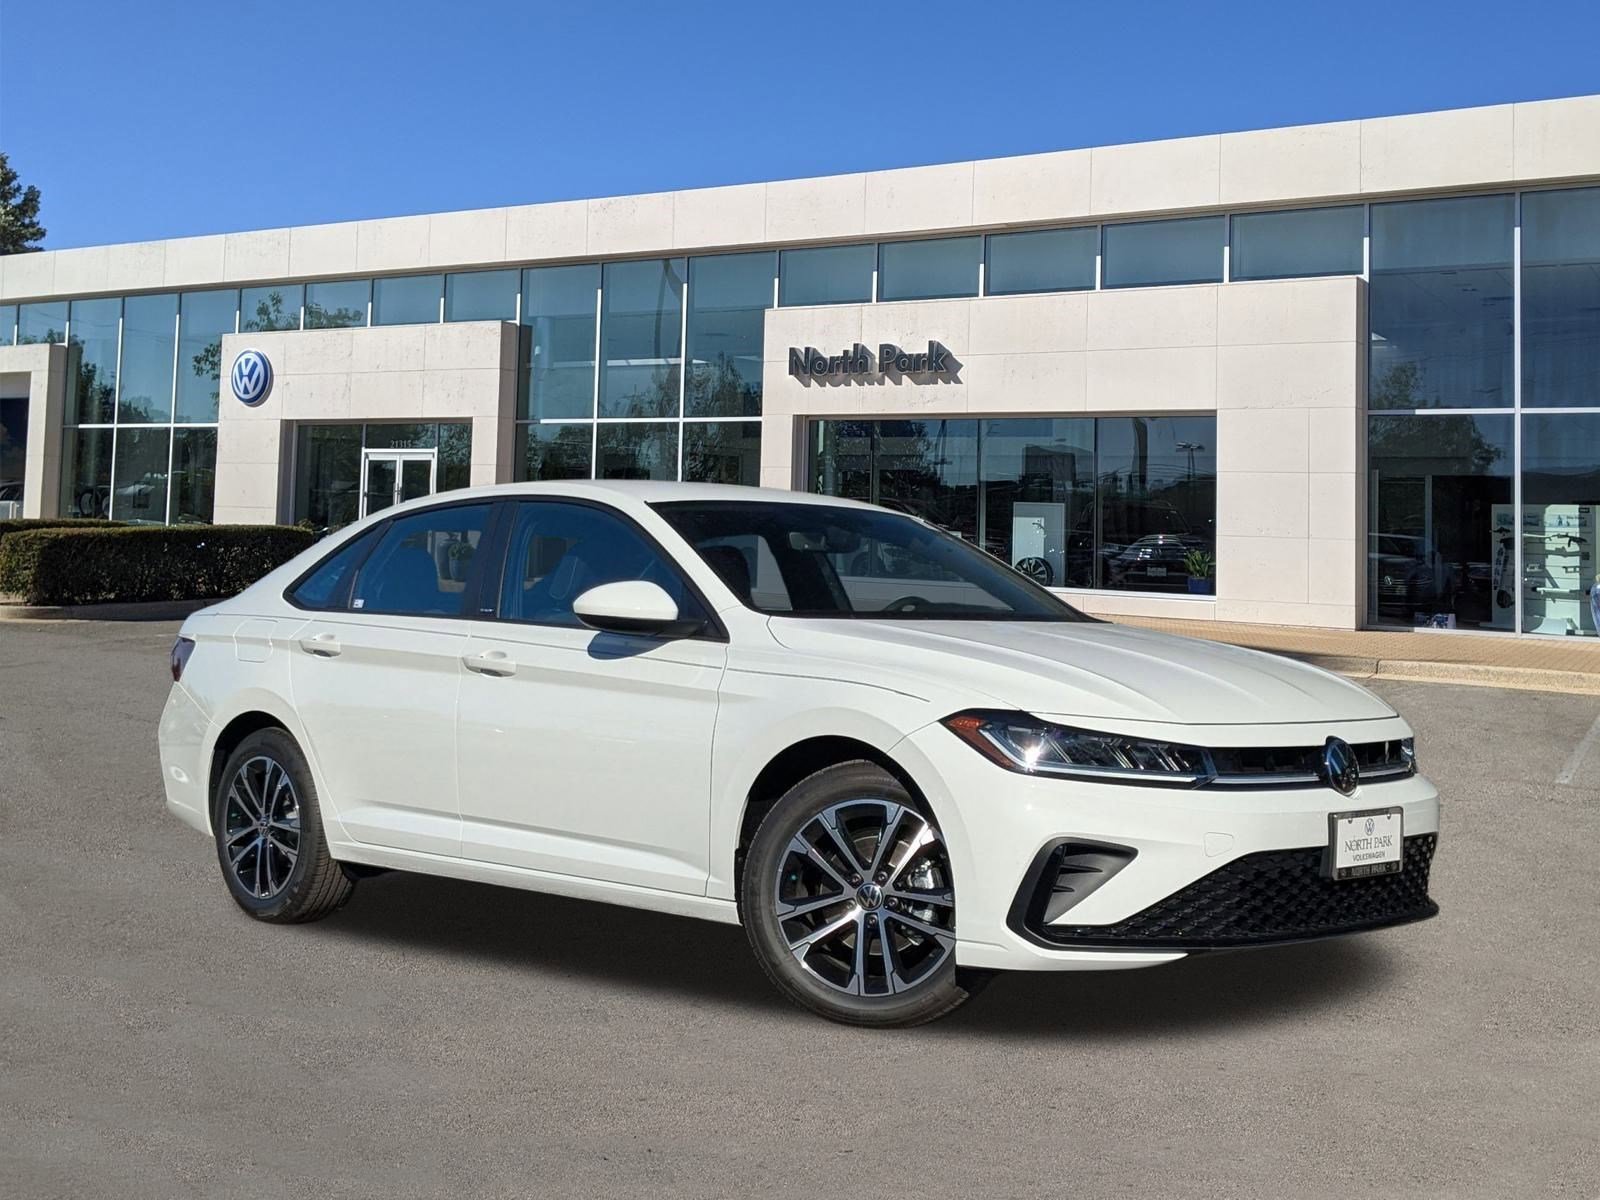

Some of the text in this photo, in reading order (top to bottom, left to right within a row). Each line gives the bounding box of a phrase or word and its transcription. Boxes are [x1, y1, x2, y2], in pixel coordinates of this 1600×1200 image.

[788, 340, 947, 375] North Park
[231, 348, 270, 404] VW
[390, 440, 412, 448] 21315
[1344, 835, 1393, 852] NORTH PARK
[857, 883, 883, 911] VW
